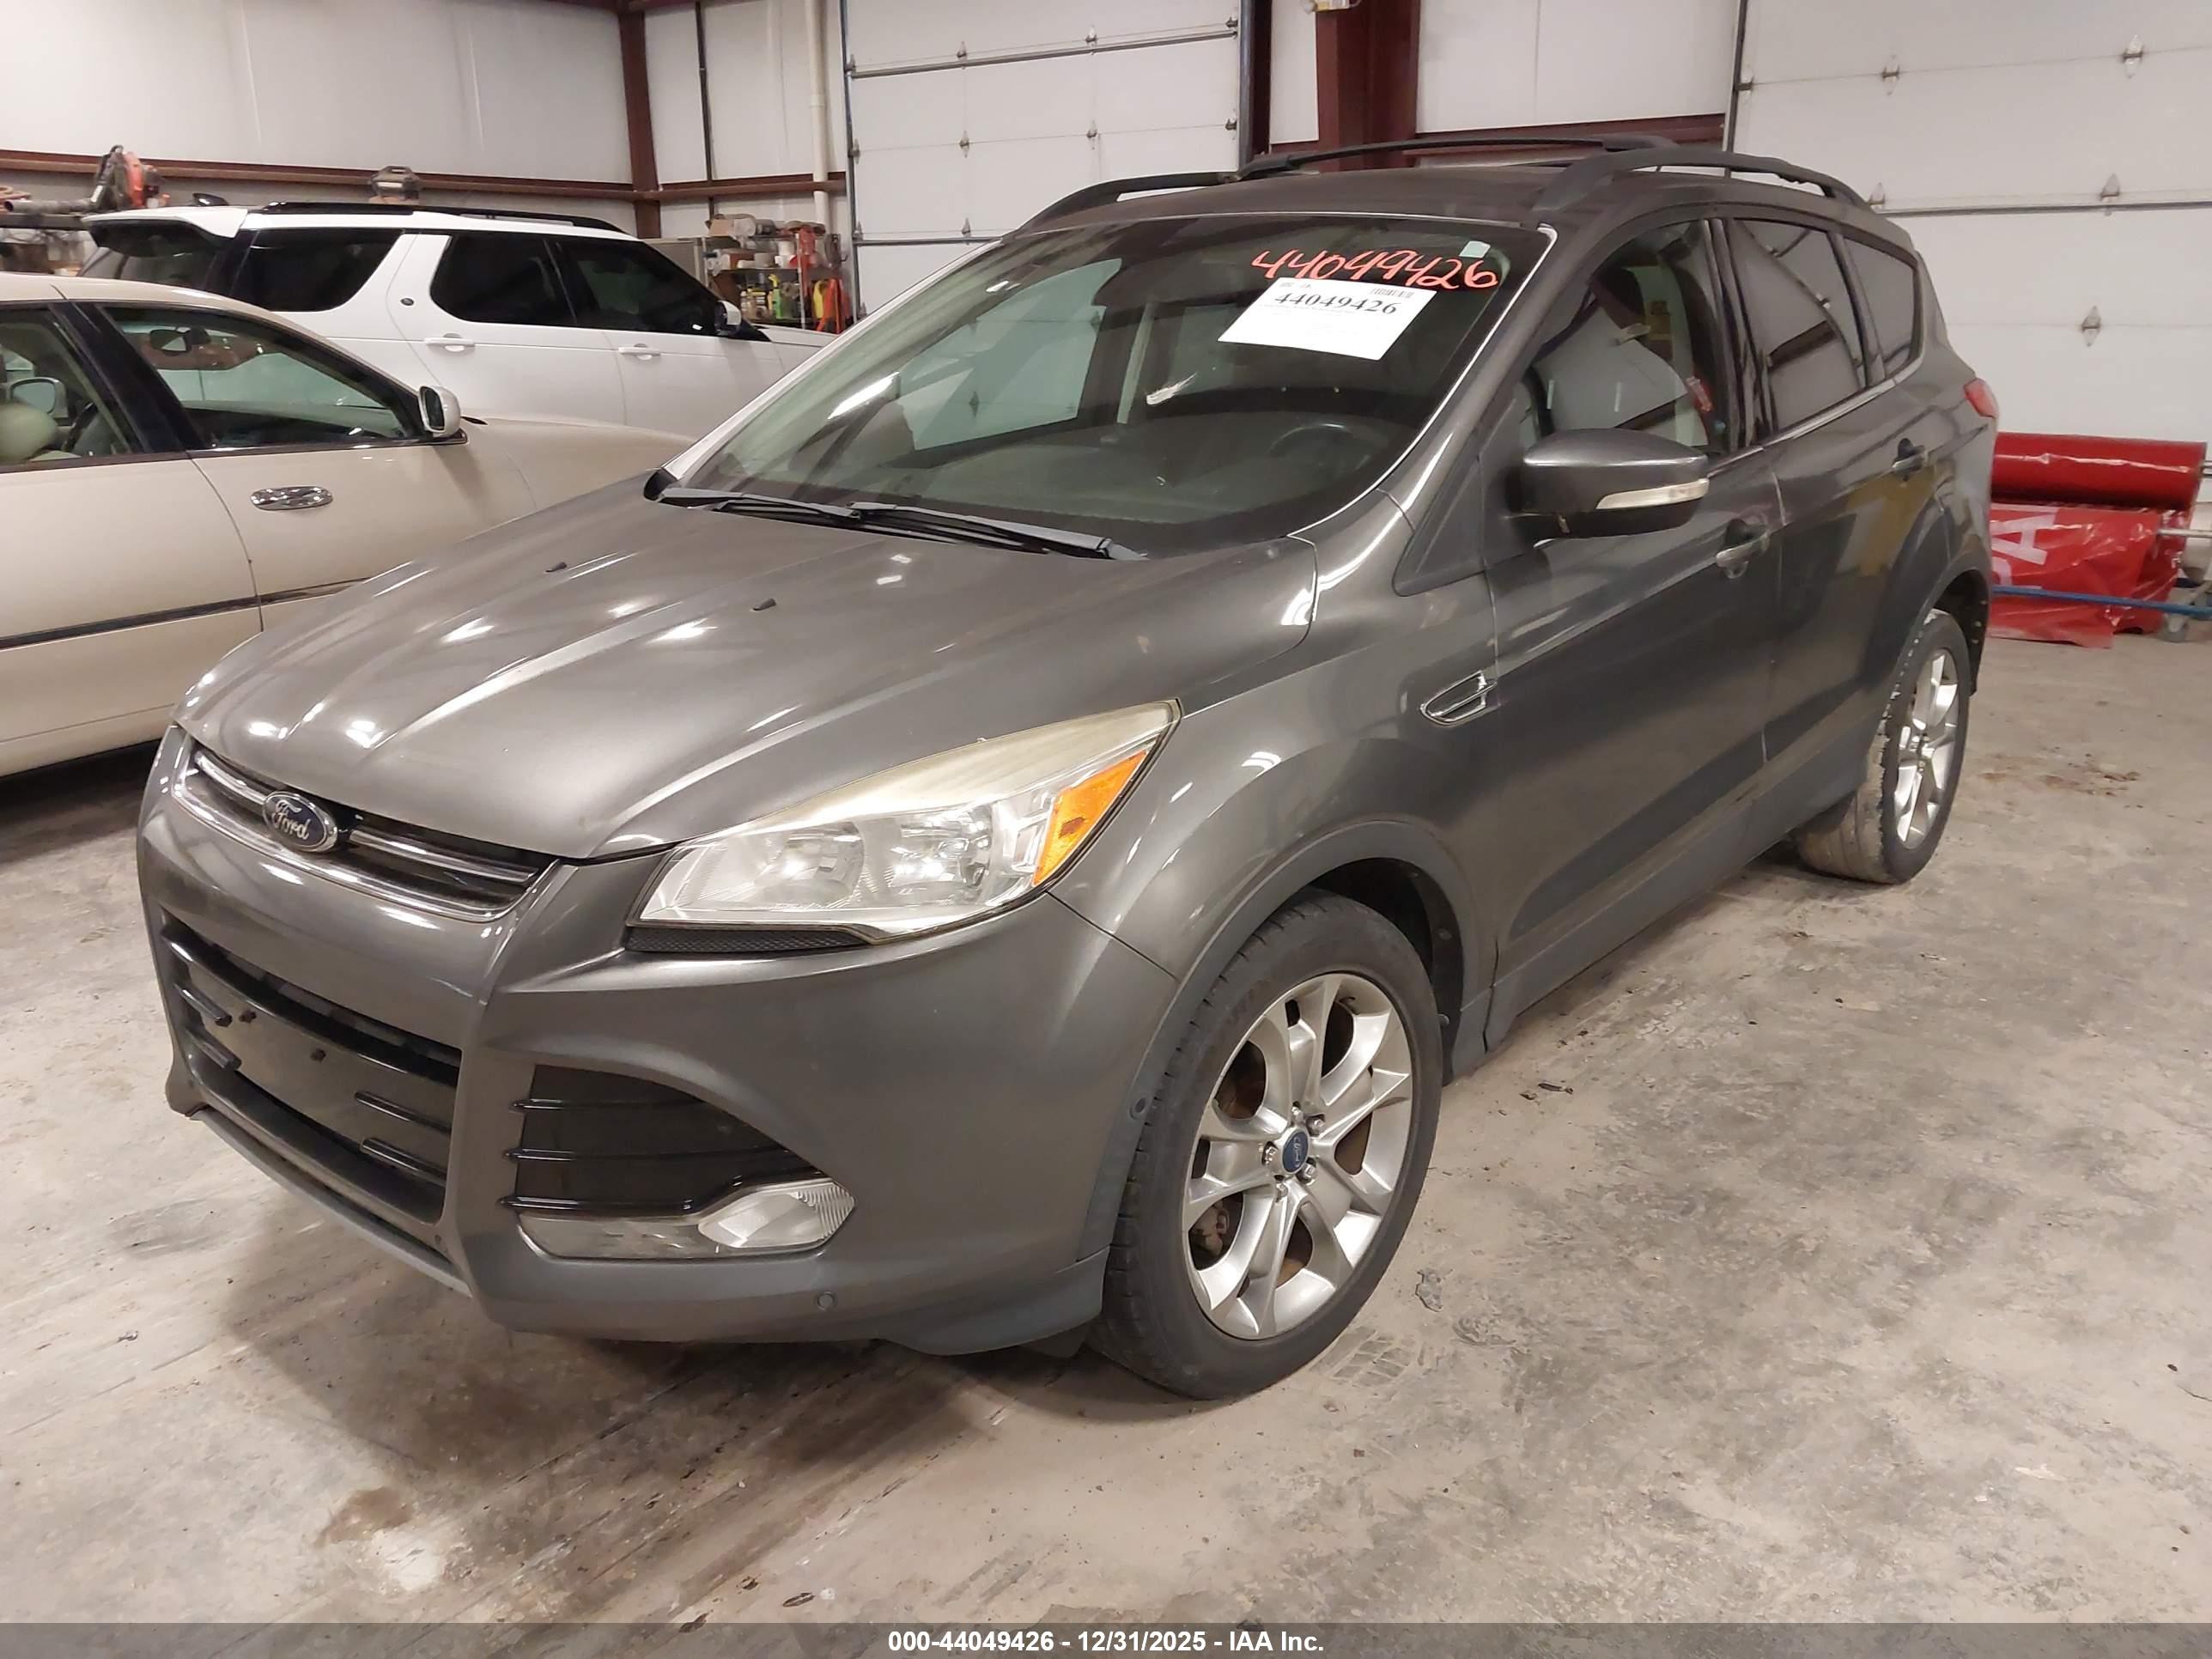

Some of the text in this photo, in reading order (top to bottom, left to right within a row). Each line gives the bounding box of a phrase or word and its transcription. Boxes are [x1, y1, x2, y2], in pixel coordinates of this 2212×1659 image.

[1252, 249, 1498, 289] 44049426
[1274, 293, 1402, 314] 44049426
[271, 799, 313, 840] Ford
